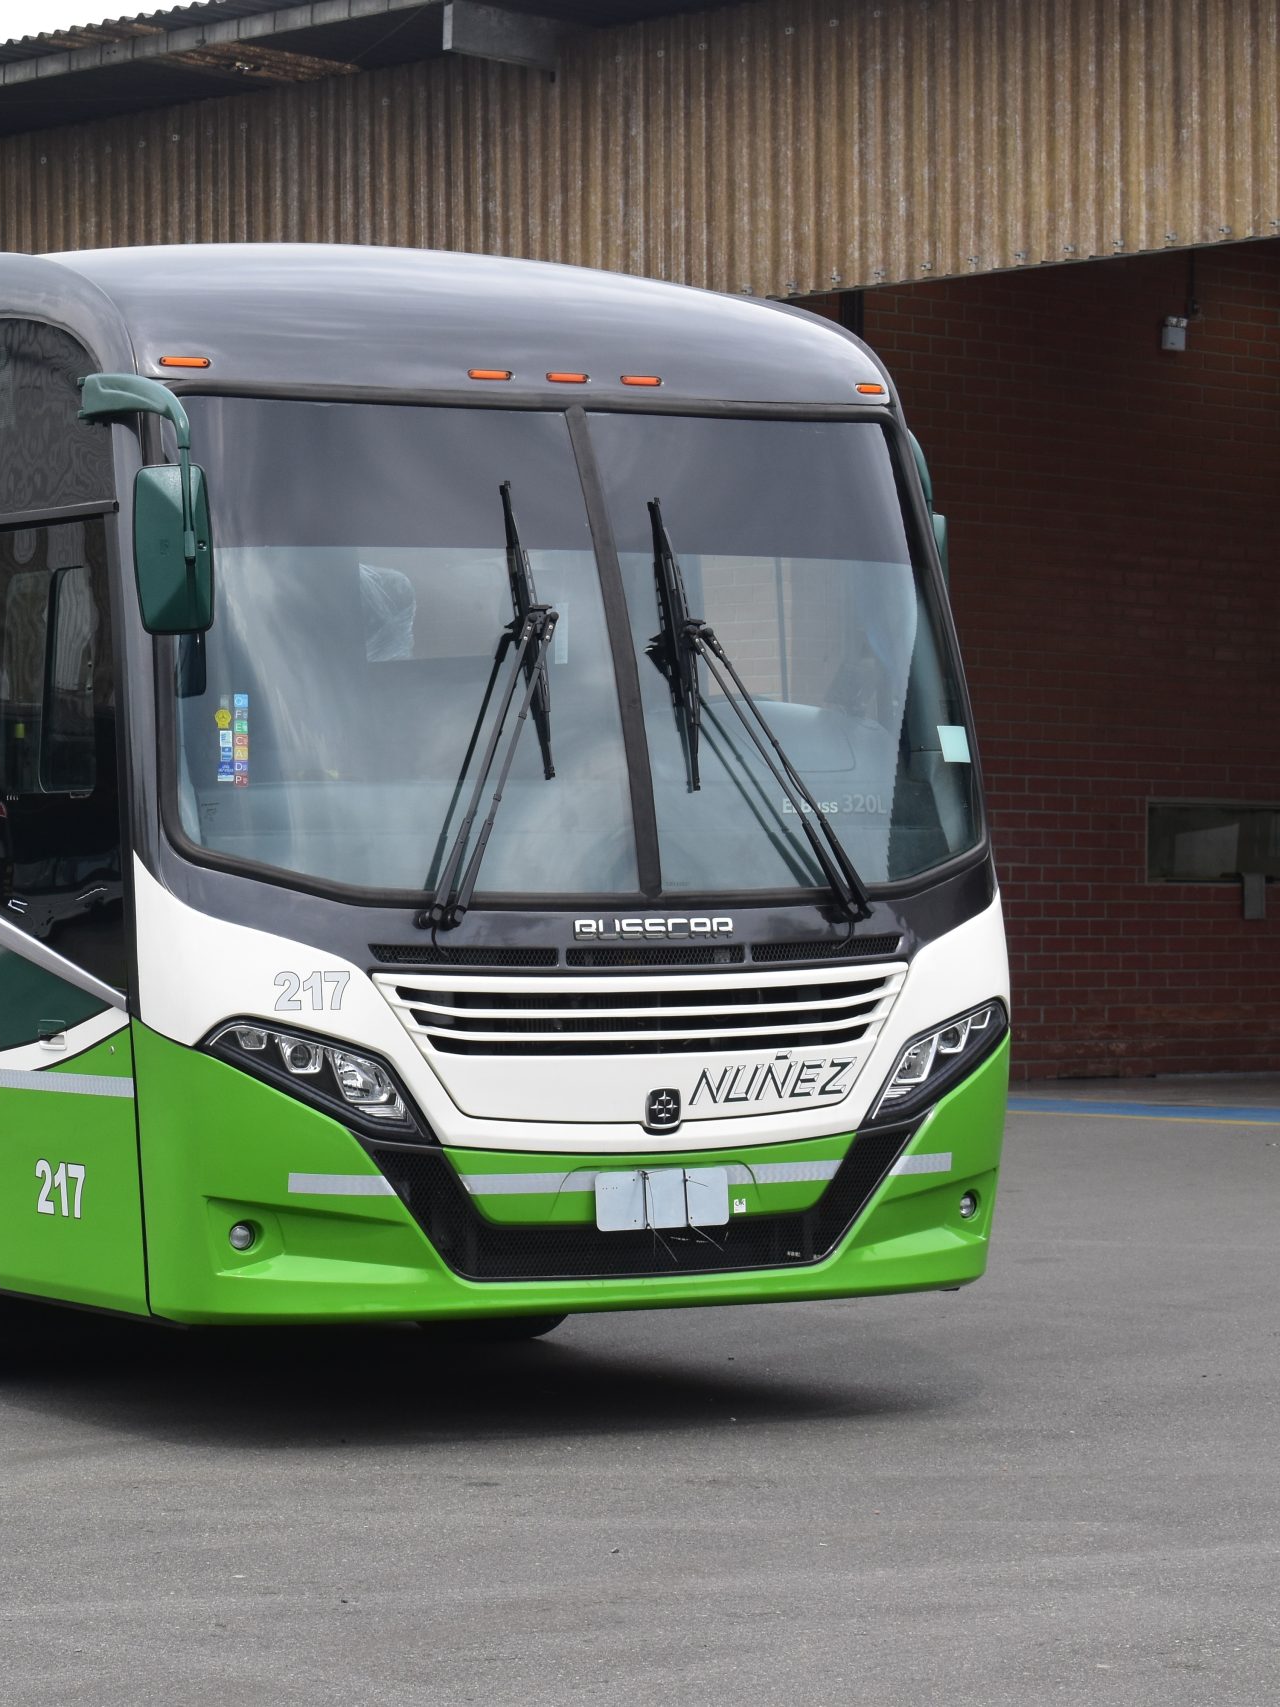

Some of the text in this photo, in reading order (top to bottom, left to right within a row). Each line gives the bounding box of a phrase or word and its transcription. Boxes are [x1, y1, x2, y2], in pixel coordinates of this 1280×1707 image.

[842, 794, 888, 814] 320L
[573, 917, 734, 940] BUSSCAR
[273, 971, 350, 1011] 217
[35, 1158, 86, 1220] 217
